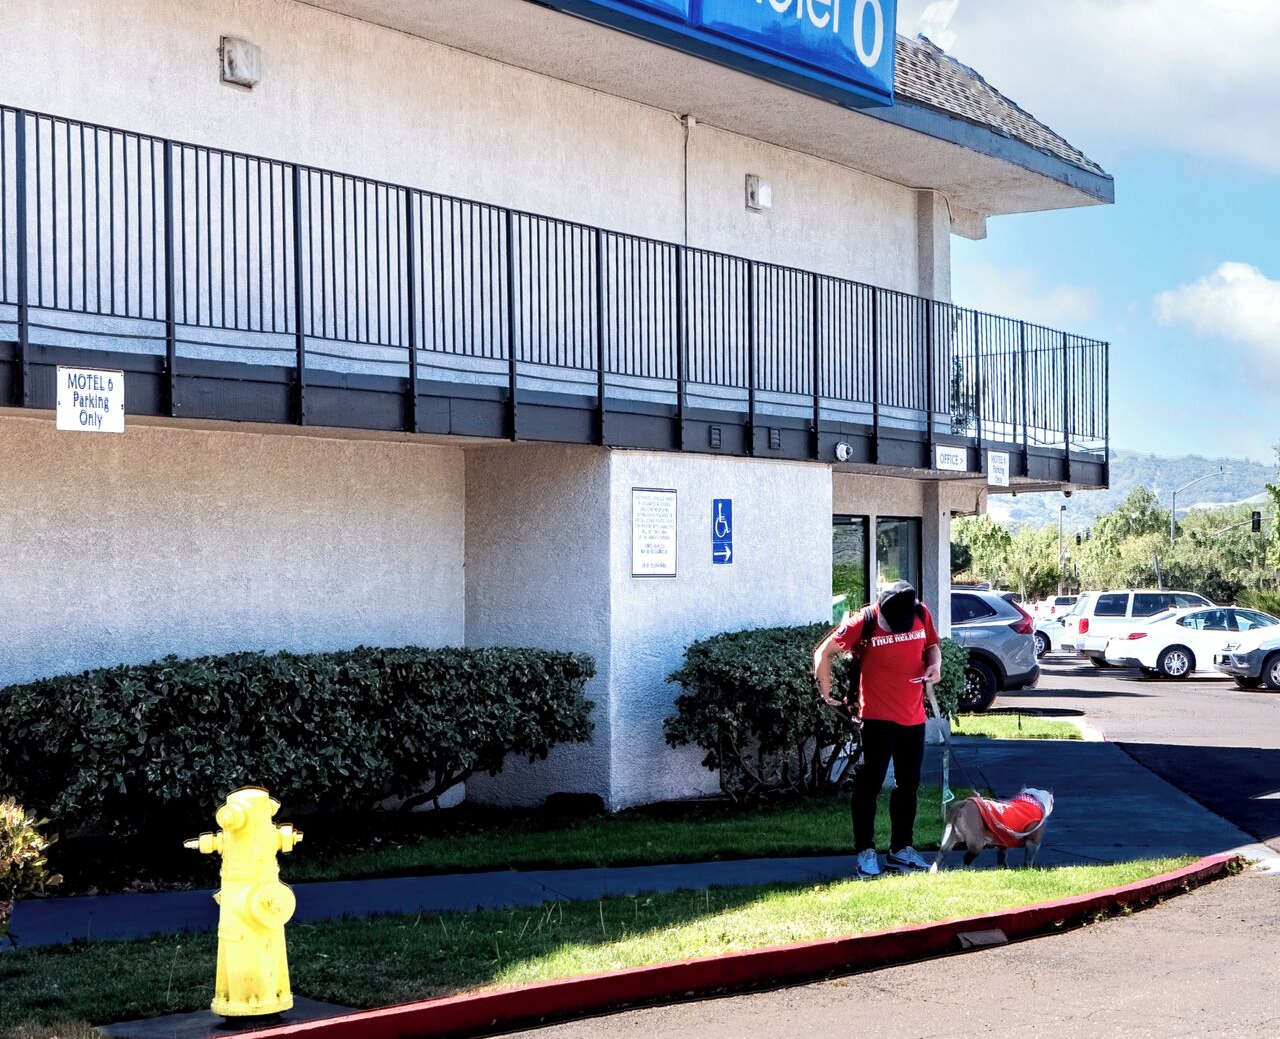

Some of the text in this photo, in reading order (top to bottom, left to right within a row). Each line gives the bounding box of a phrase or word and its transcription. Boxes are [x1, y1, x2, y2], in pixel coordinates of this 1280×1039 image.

[67, 372, 114, 392] MOTEL 6
[72, 390, 110, 413] Parking
[79, 409, 103, 430] Only
[939, 453, 959, 466] OFFICE
[871, 634, 895, 648] TRUE
